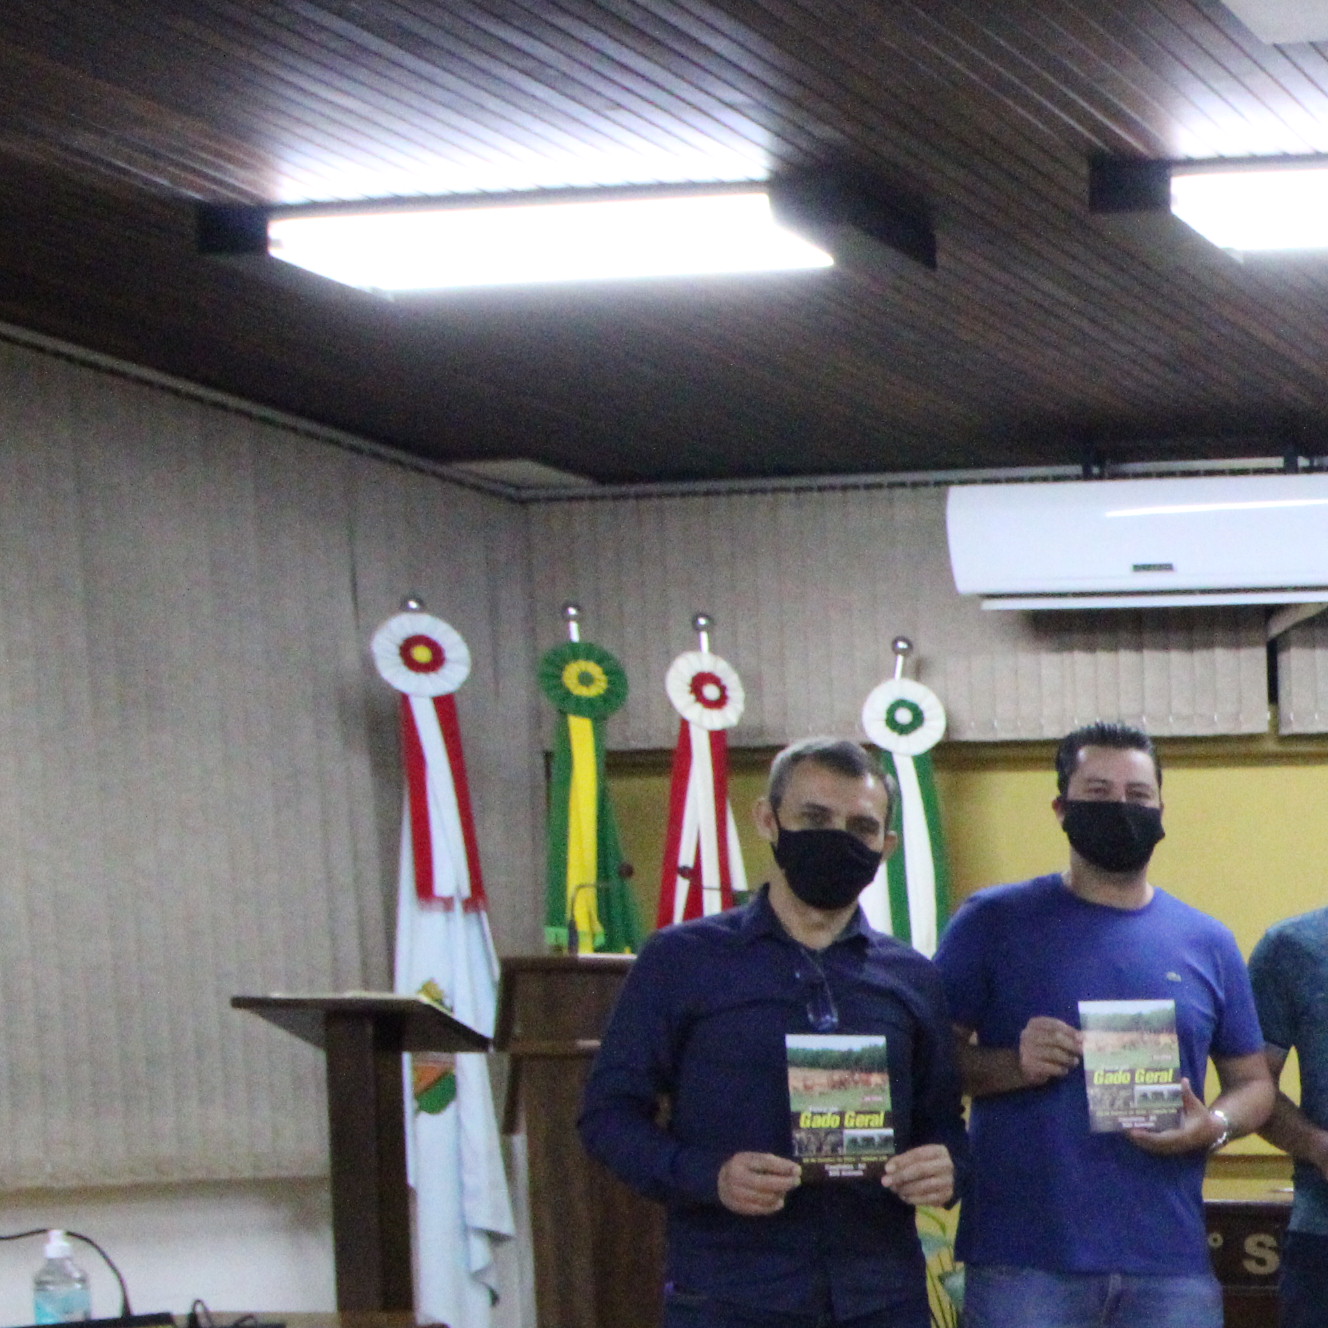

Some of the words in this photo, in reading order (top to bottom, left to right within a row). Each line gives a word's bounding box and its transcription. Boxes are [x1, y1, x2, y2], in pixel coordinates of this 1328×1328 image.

[1094, 1069, 1130, 1085] Gado
[1135, 1068, 1174, 1083] Geral
[800, 1112, 840, 1128] Gado
[844, 1111, 885, 1128] Geral
